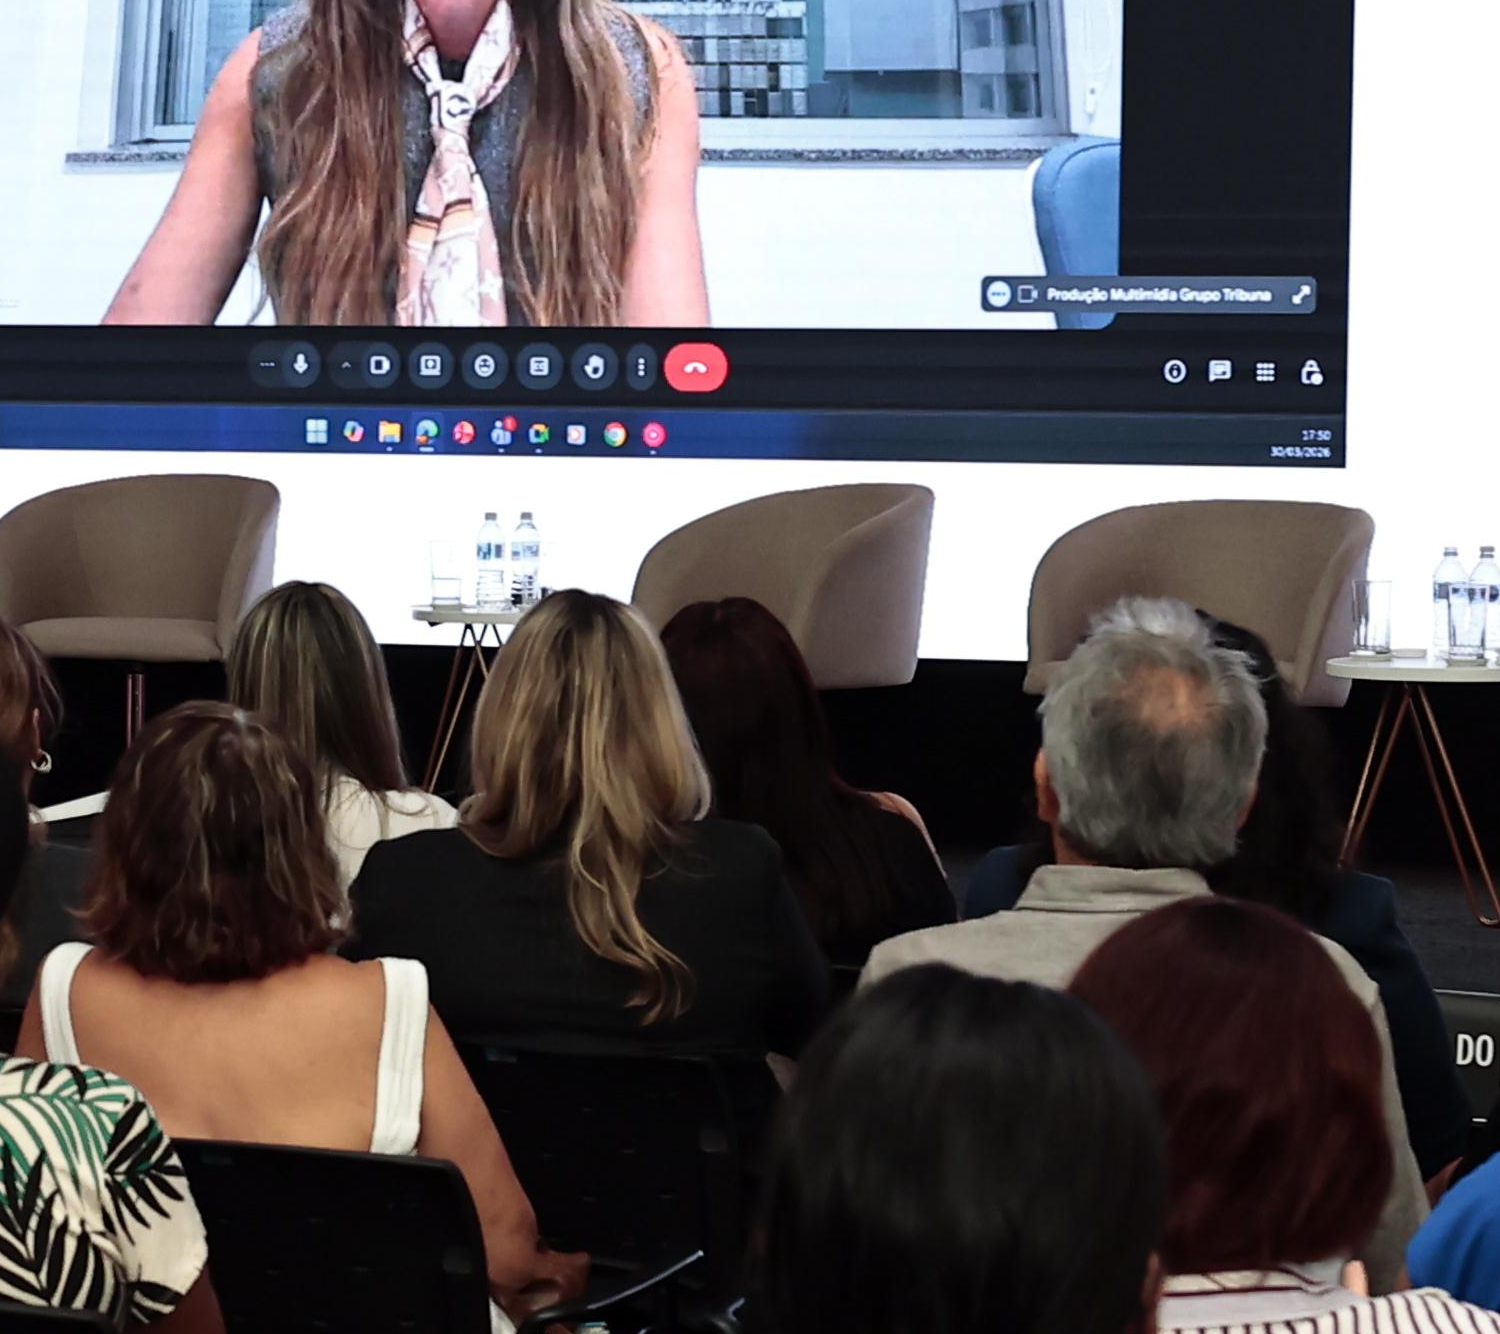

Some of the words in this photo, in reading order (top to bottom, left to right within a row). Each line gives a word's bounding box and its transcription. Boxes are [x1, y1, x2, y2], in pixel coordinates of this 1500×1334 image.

[1046, 286, 1108, 305] Produção
[1179, 286, 1223, 305] Grupo
[1223, 286, 1272, 303] Tribuna
